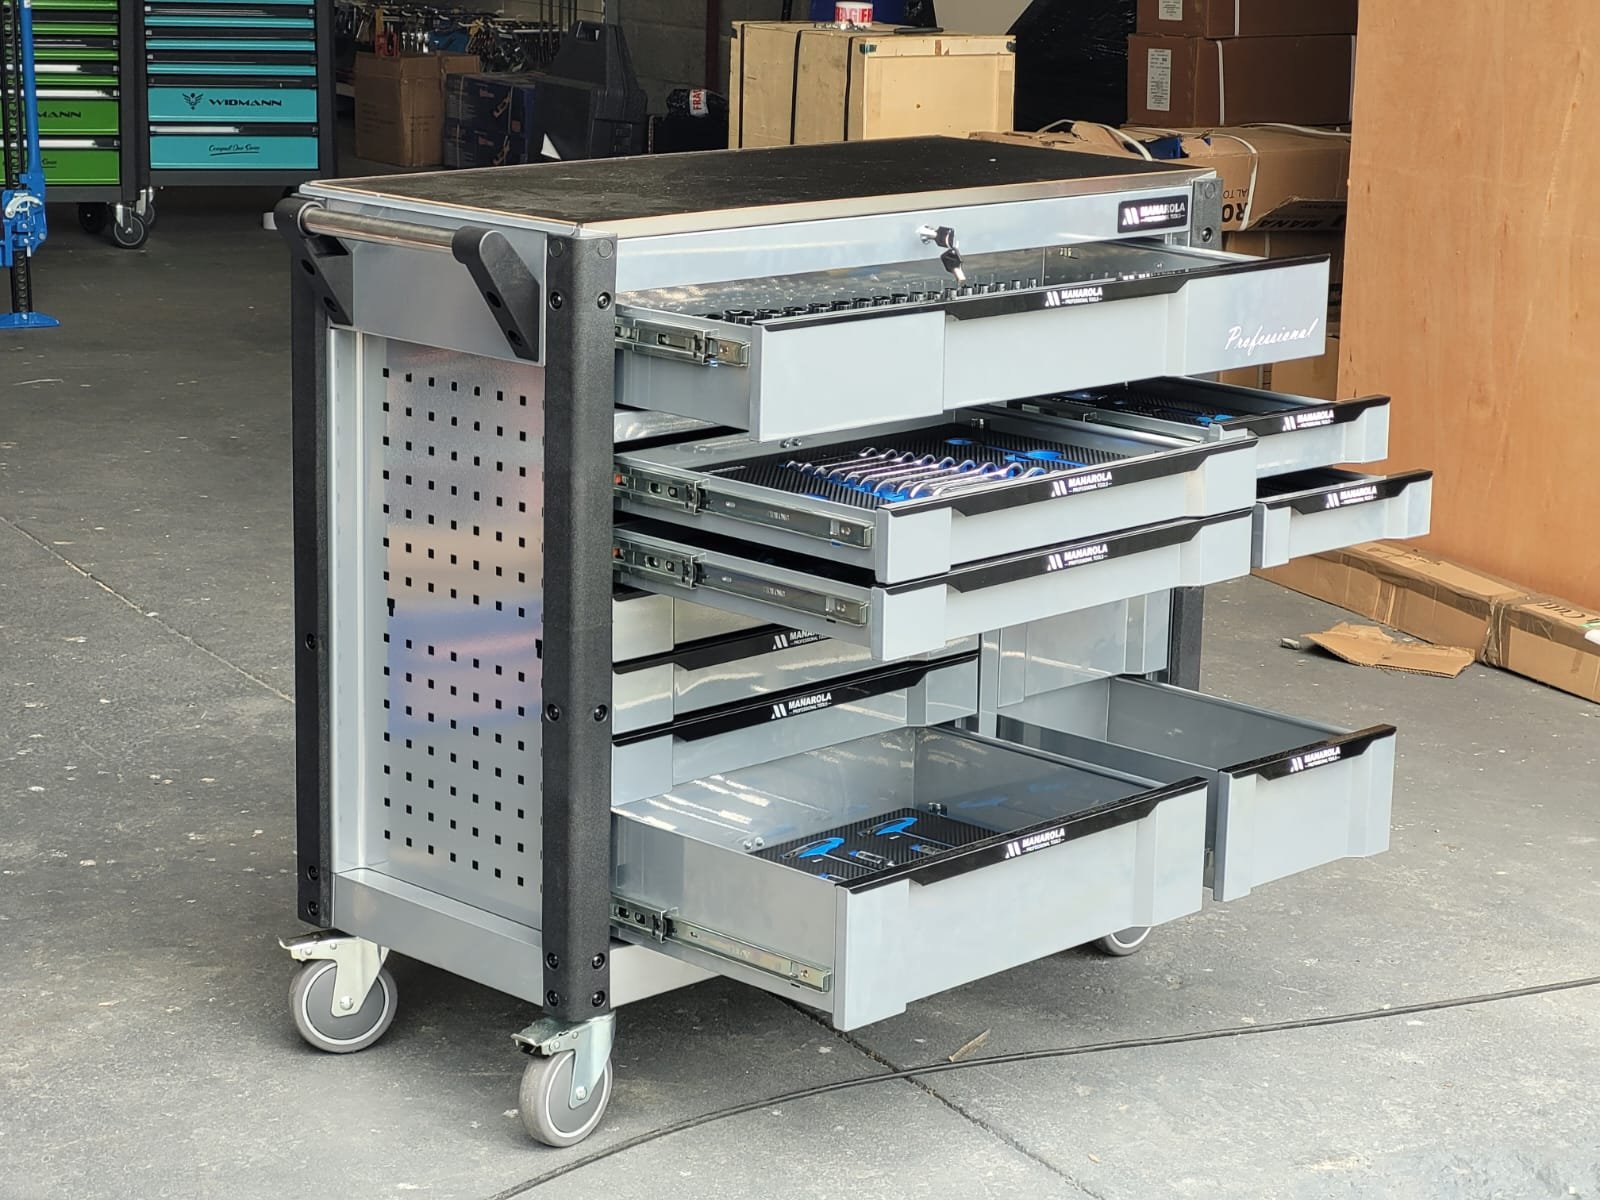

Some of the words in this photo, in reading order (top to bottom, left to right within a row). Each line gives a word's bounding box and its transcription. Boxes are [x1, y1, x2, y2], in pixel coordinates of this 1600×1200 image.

[209, 99, 282, 107] WIDMANN
[1140, 202, 1186, 217] MANAROLA
[1061, 287, 1103, 299] MANAROLA
[1224, 317, 1319, 357] Professional
[1068, 471, 1112, 487] MANAROLA
[1064, 544, 1108, 561] MANAROLA
[788, 692, 832, 709] MANAROLA
[1022, 828, 1065, 848] MANAROLA
